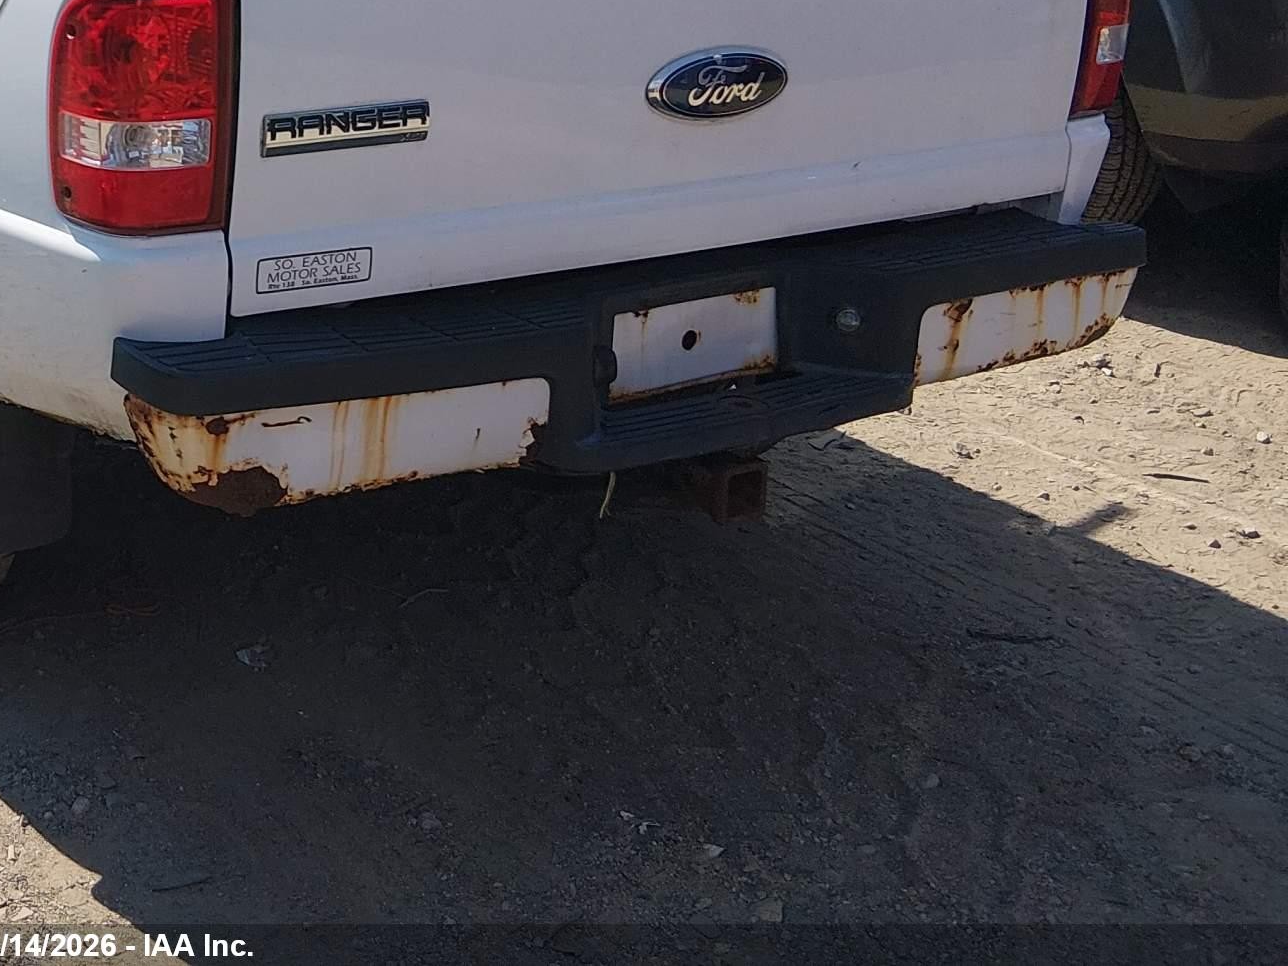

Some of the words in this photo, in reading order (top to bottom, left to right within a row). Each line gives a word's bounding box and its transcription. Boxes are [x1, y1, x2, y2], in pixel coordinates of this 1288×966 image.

[688, 65, 765, 107] Ford
[266, 104, 429, 141] RANGER
[267, 267, 319, 283] MOTOR
[322, 262, 361, 277] SALES
[274, 259, 296, 270] SO.
[302, 252, 357, 268] EASTON
